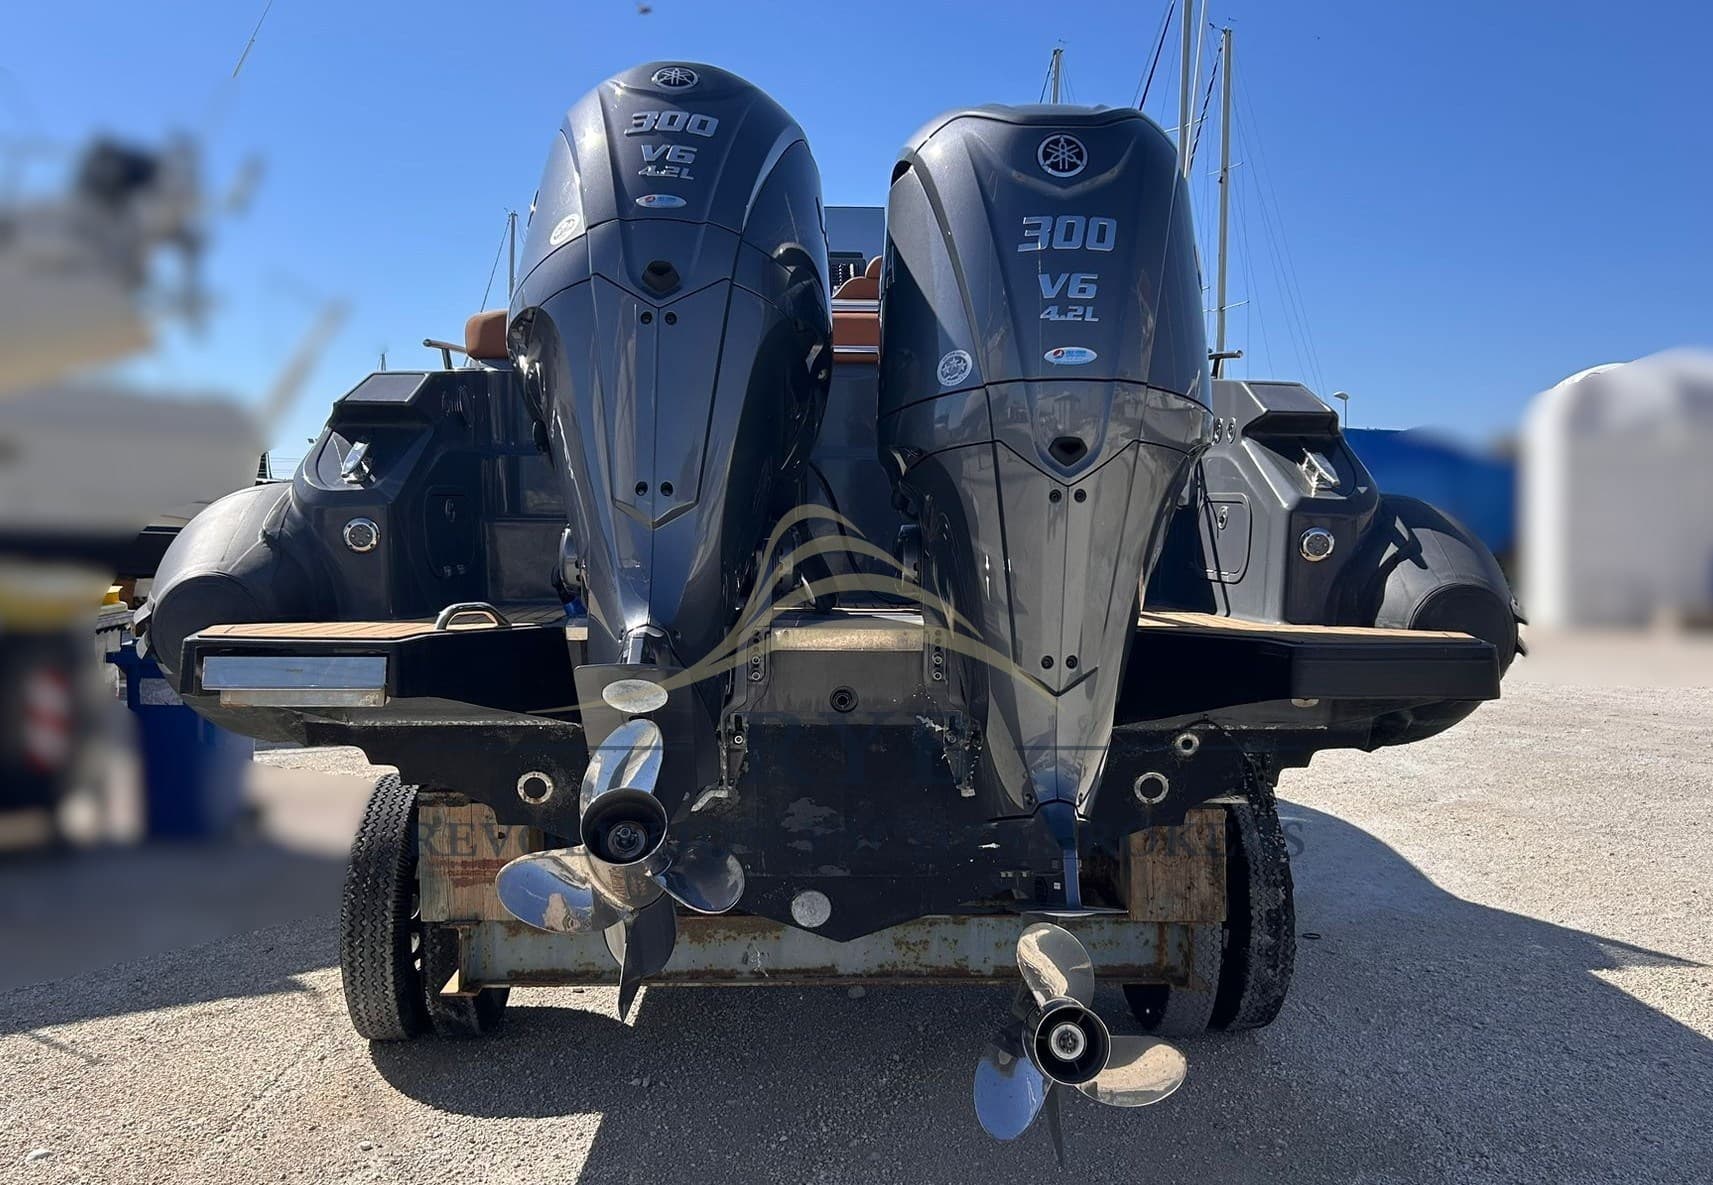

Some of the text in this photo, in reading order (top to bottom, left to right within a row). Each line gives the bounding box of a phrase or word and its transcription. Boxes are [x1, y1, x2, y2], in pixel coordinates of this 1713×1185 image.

[624, 111, 719, 137] 300
[641, 144, 698, 163] V6
[638, 165, 695, 180] 4.2L
[1017, 215, 1117, 252] 300
[1038, 273, 1098, 299] V6
[1039, 306, 1100, 322] 4.2L
